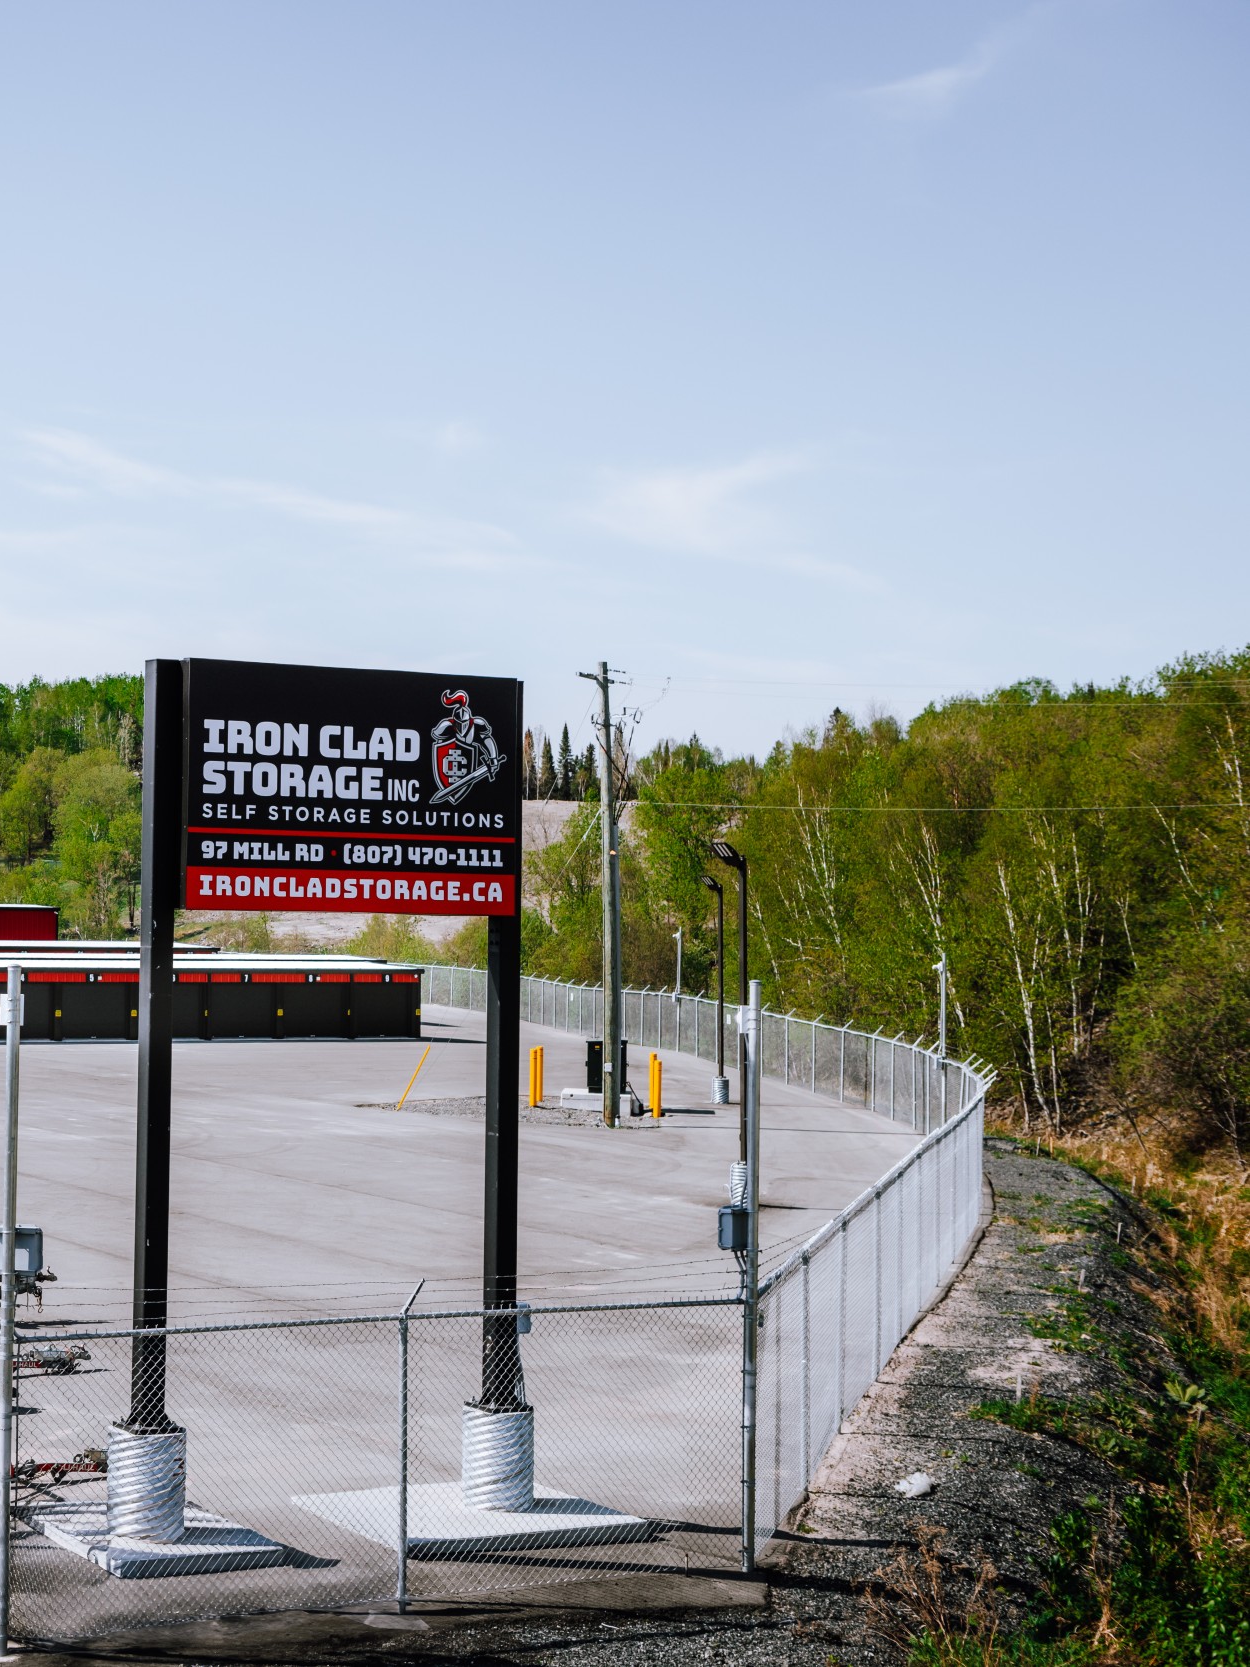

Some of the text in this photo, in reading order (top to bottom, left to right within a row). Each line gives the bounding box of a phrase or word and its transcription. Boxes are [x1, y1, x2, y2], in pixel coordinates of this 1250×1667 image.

[203, 718, 421, 762] IRON CLAD
[202, 760, 420, 803] STORAGE INC
[202, 803, 504, 829] SELF STORAGE SOLUTIONS
[201, 840, 504, 868] 97 MILL RD (807) 470-1111
[199, 874, 503, 903] IRONCLADSTORAGE.CA
[89, 973, 94, 982] 5
[244, 974, 249, 983] 7
